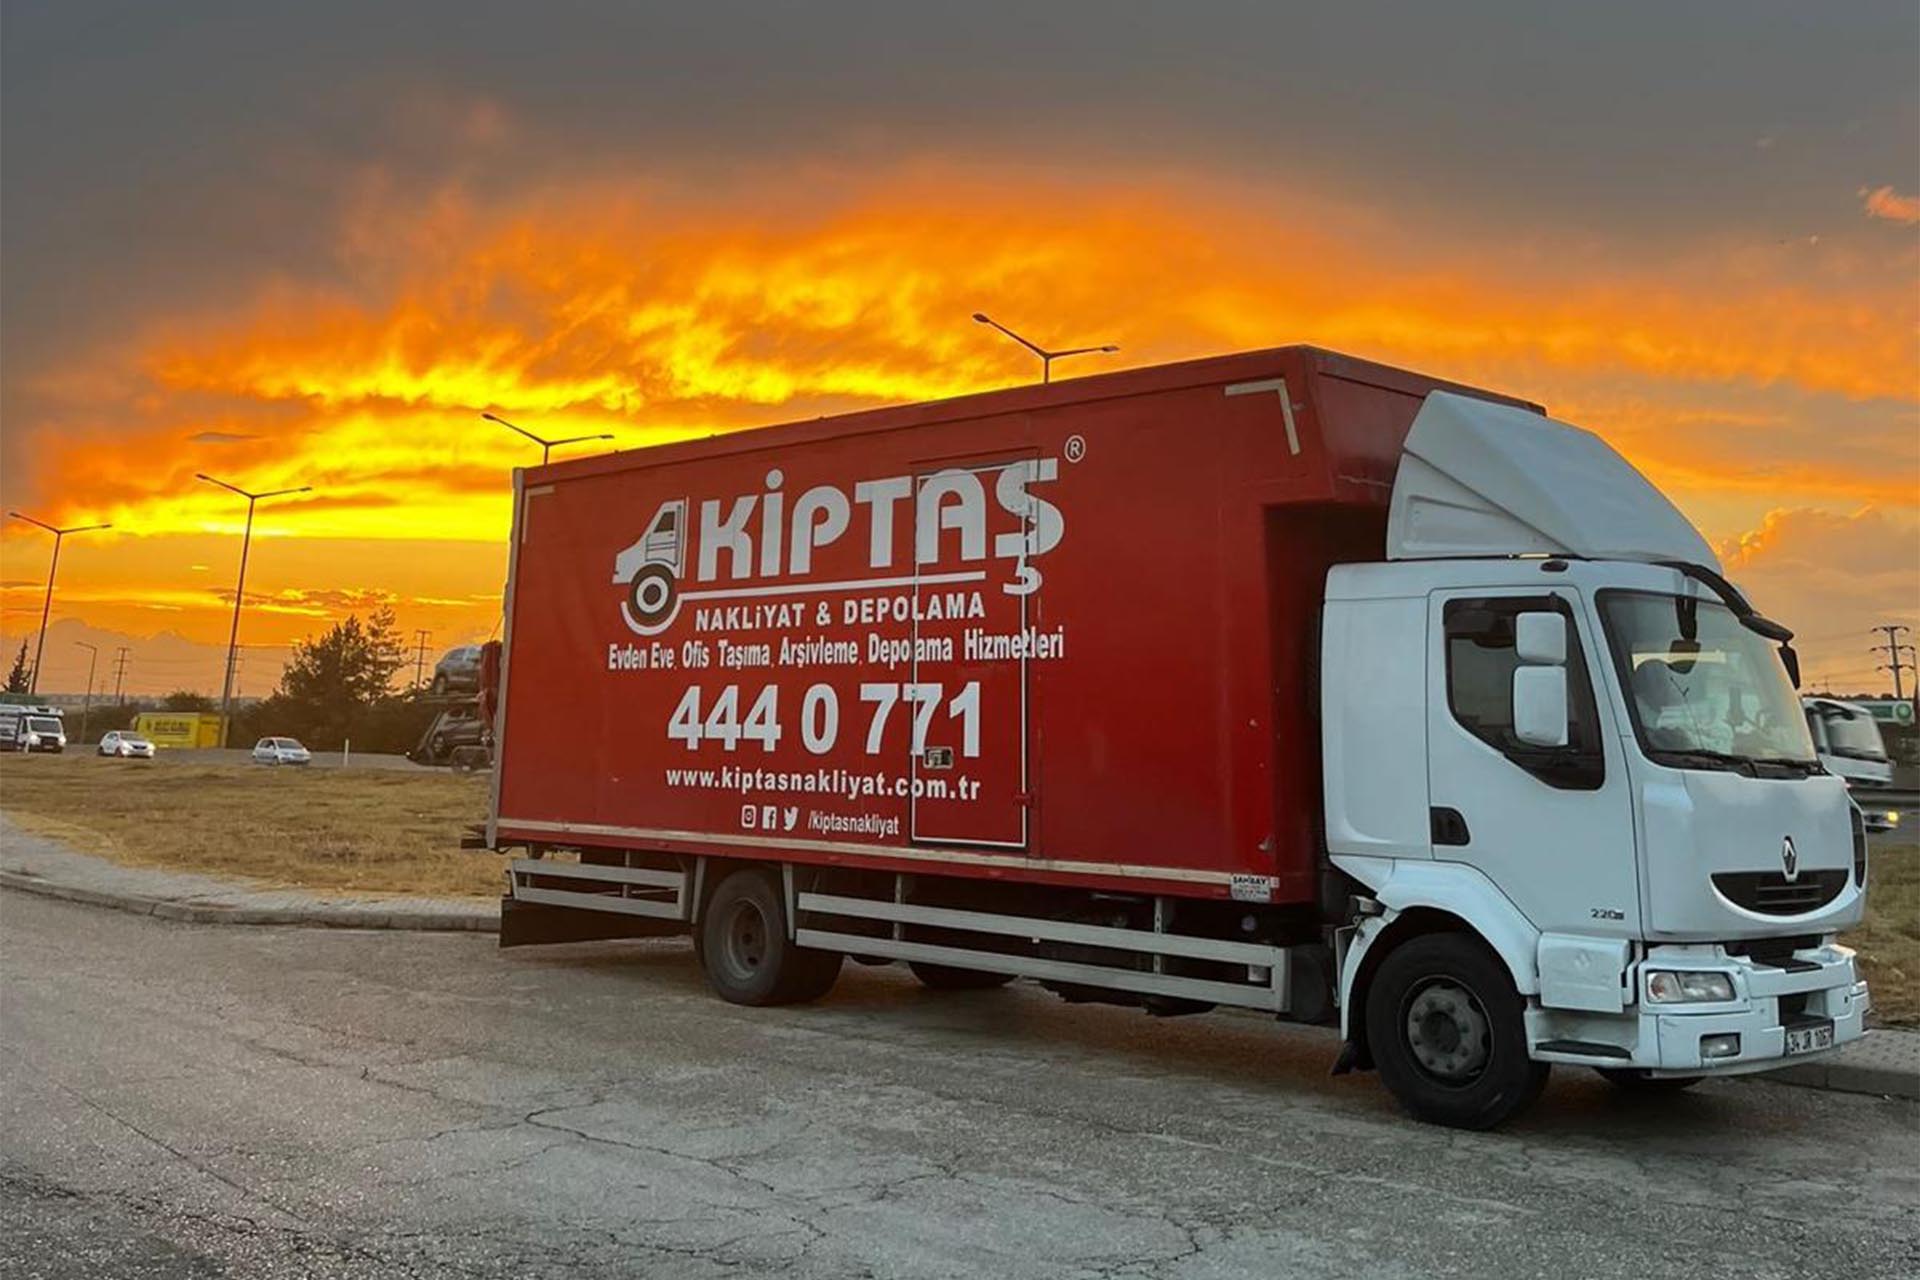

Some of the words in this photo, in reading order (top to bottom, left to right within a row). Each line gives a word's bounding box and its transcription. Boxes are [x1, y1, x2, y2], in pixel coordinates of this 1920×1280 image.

[815, 601, 832, 626] &
[843, 592, 986, 625] DEPOLAMA
[608, 643, 647, 669] Evden
[682, 640, 710, 668] Ofis
[868, 633, 953, 670] Depoama
[667, 684, 782, 752] 444
[801, 683, 839, 754] 0
[859, 681, 981, 758] 771
[666, 766, 981, 801] www.kiptasnakliyat.com.tr
[808, 811, 900, 838] /kiptasnakliyat
